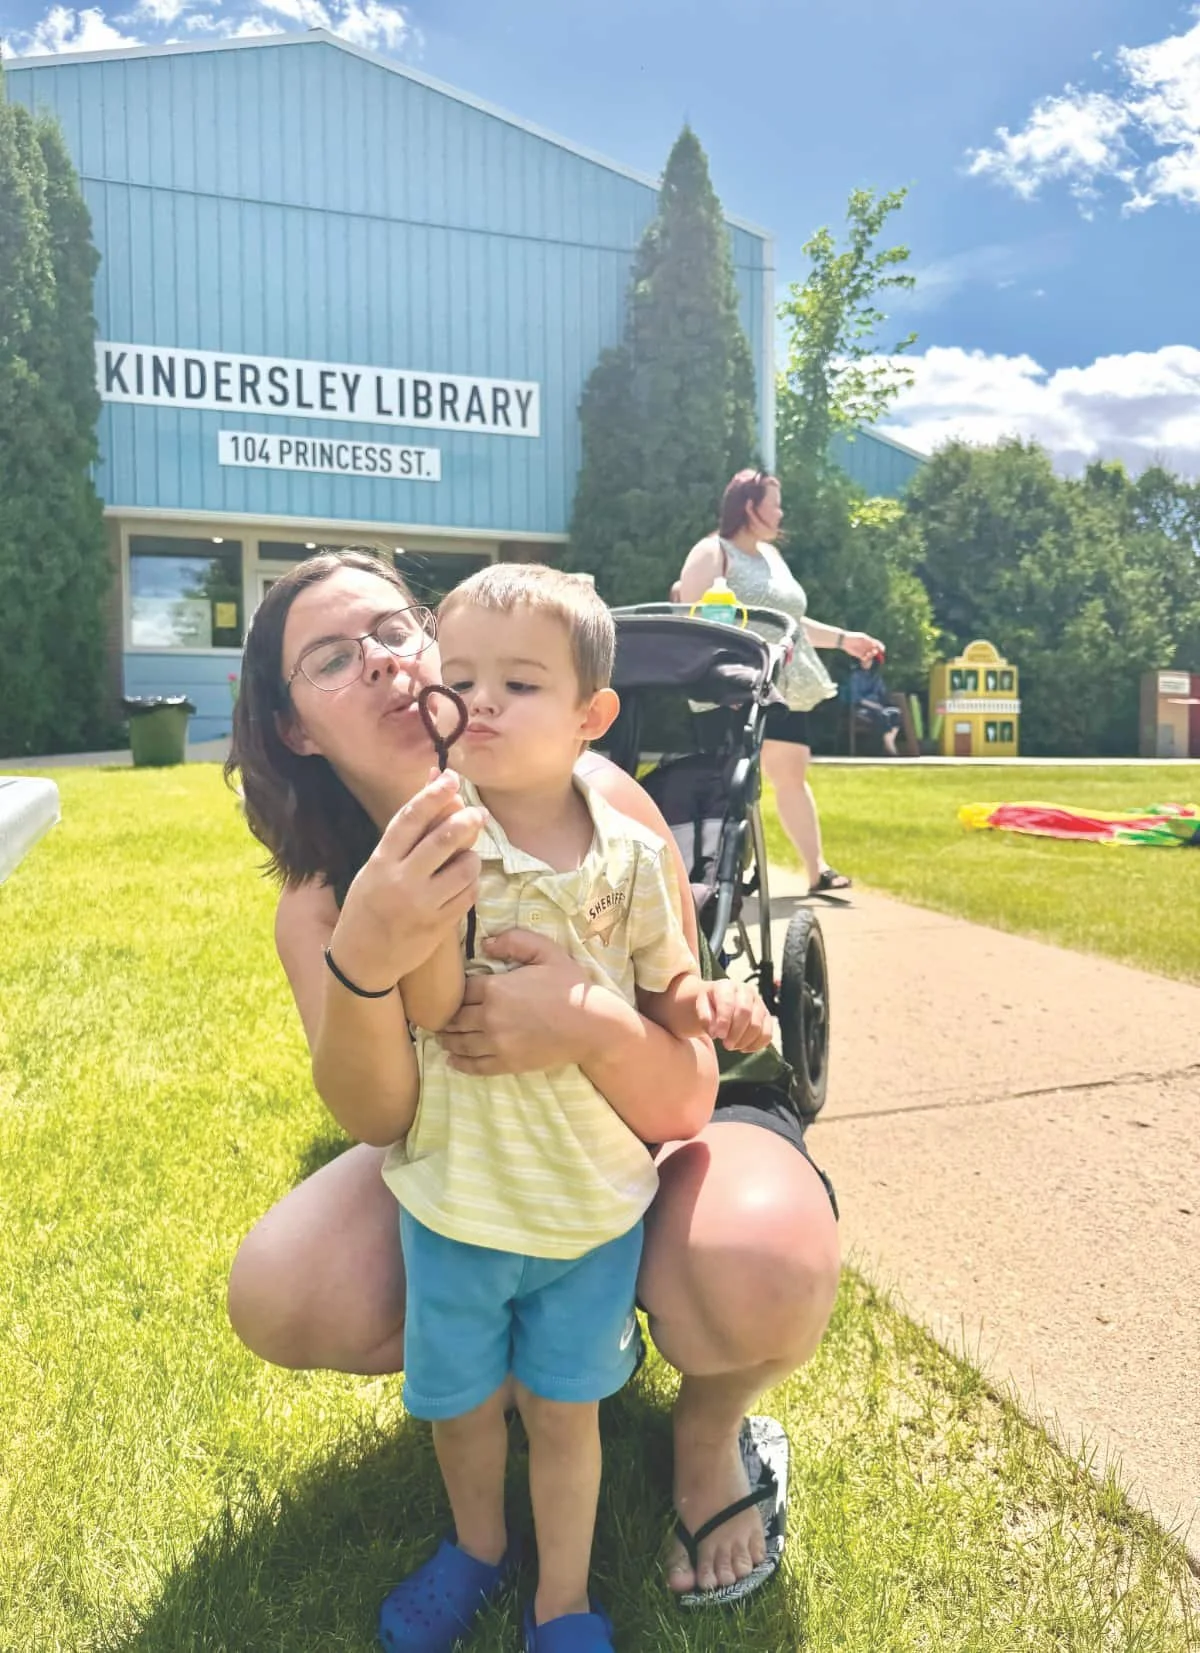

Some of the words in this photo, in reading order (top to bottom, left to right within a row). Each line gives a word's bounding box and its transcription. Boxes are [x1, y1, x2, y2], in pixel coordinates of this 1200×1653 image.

[105, 351, 361, 413] KINDERSLEY
[376, 376, 533, 428] LIBRARY
[231, 436, 271, 463] 104
[279, 440, 391, 473] PRINCESS
[399, 450, 432, 476] ST.
[589, 892, 624, 919] SHERIFF
